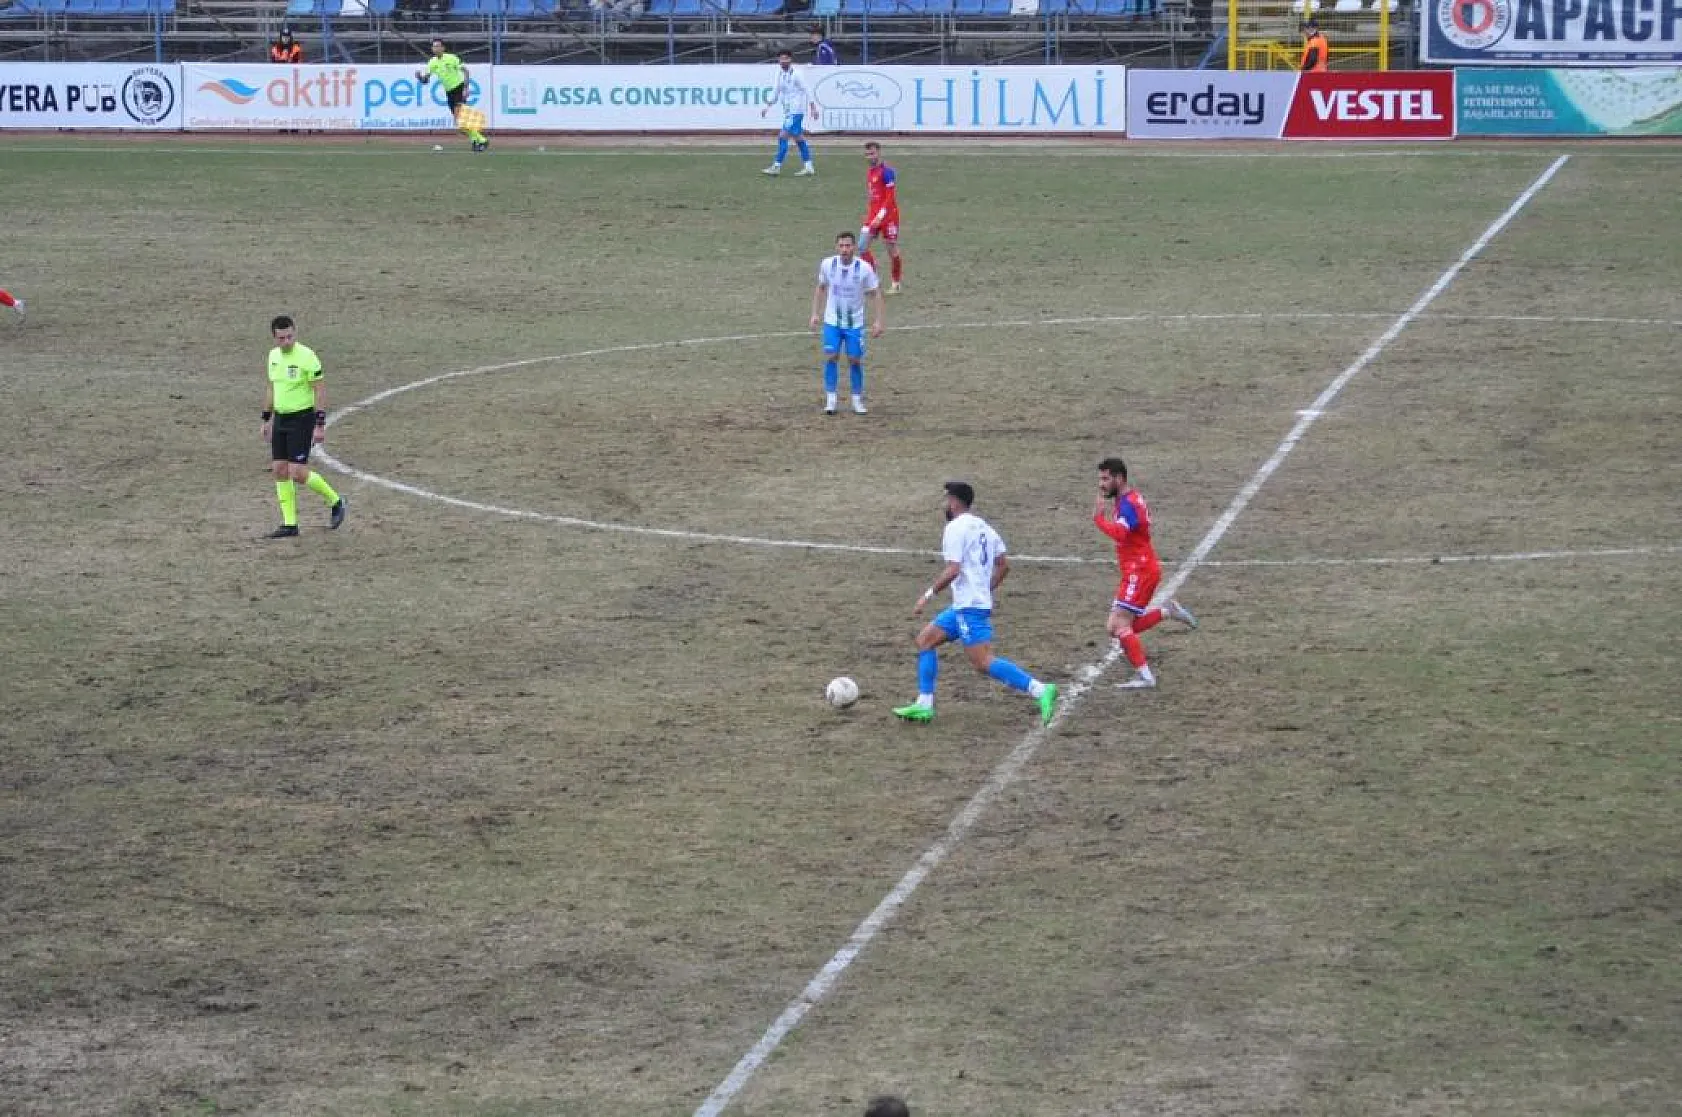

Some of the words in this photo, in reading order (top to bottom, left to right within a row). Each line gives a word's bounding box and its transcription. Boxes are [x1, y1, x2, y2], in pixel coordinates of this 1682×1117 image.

[67, 85, 116, 112] PUB
[266, 67, 357, 107] aktif
[364, 77, 481, 117] pere
[541, 87, 601, 105] ASSA
[610, 87, 780, 105] CONSTRUCTIO
[914, 69, 1109, 125] HİLMİ
[1147, 84, 1264, 125] erday
[1310, 89, 1443, 120] VESTEL
